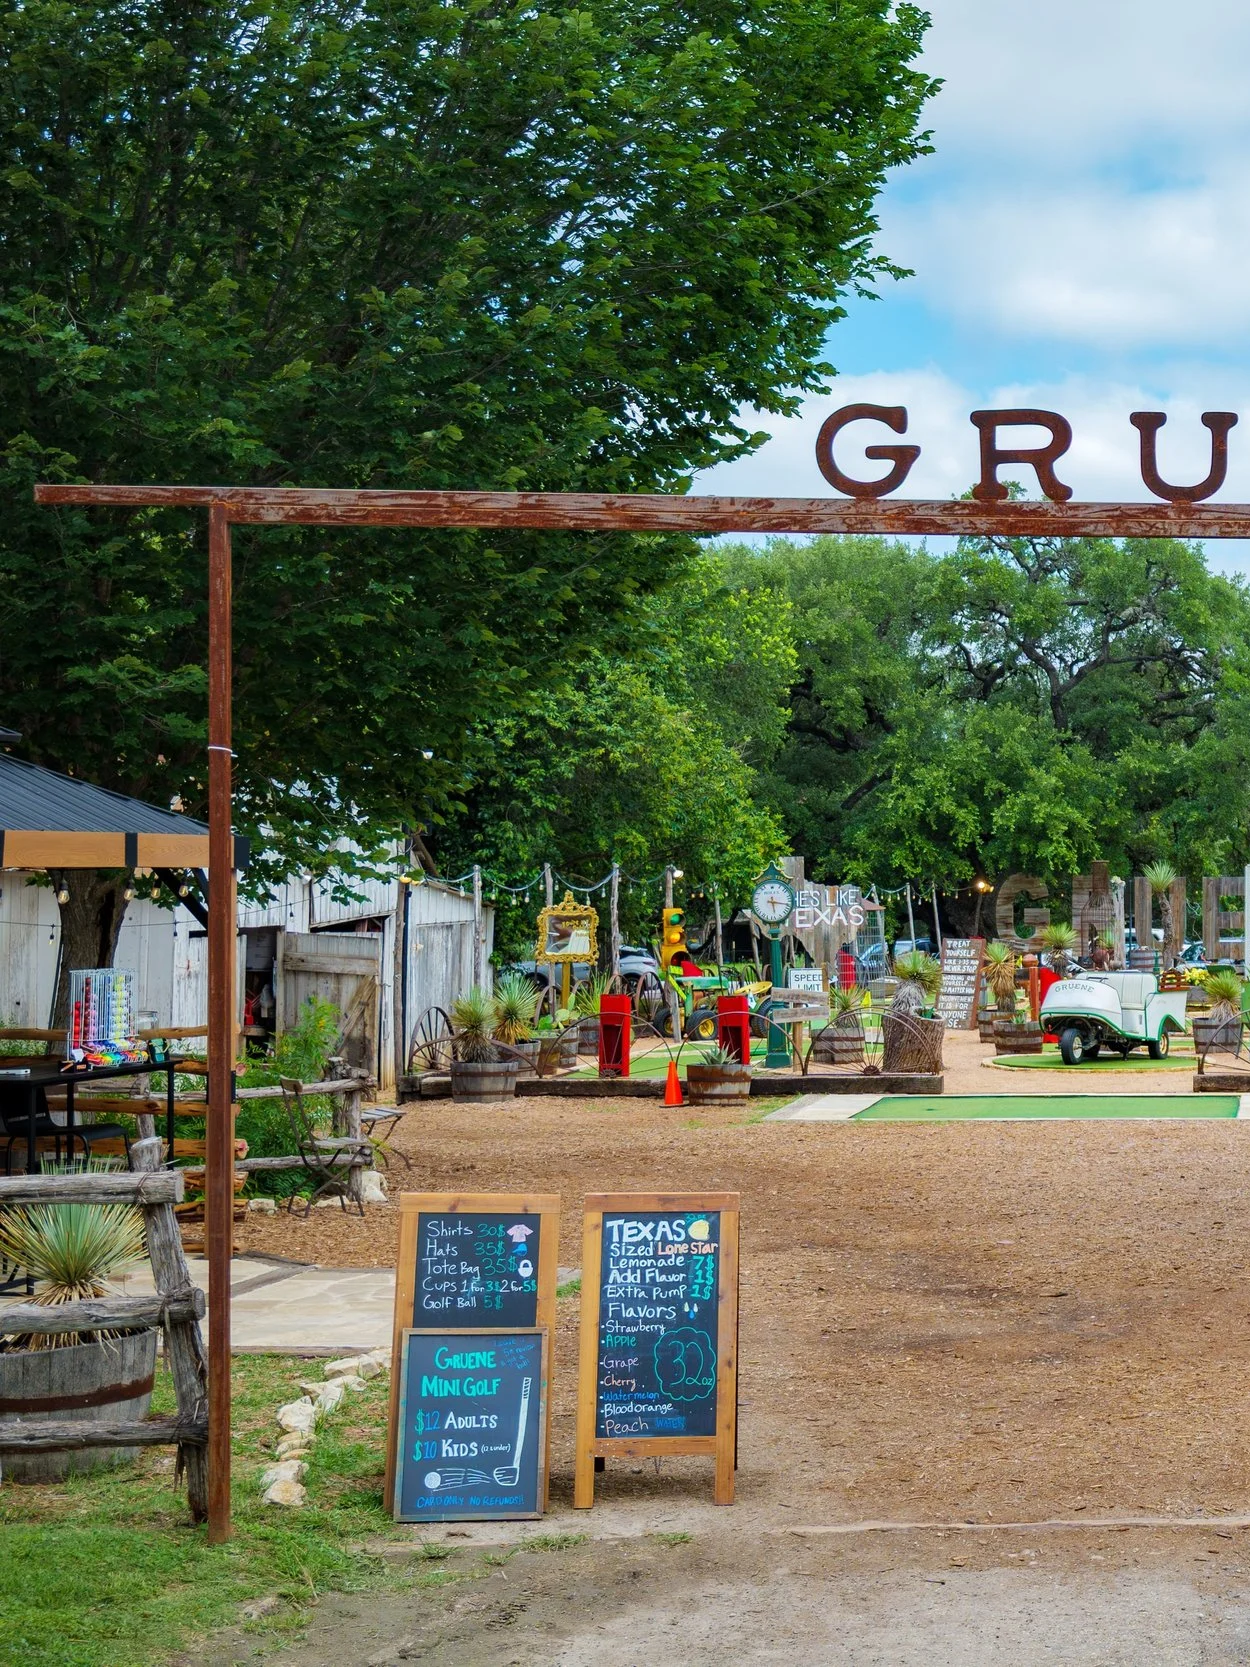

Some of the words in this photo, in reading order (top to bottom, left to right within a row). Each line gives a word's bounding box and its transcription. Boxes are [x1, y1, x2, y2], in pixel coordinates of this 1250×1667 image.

[825, 889, 860, 906] LIKE
[946, 940, 971, 948] TREAT
[945, 949, 976, 957] YOURSELF
[962, 965, 977, 973] STOP
[1054, 983, 1095, 993] GRUENE
[954, 1002, 969, 1010] FOR
[427, 1220, 474, 1237] Shirts
[477, 1223, 506, 1238] 30$
[606, 1218, 686, 1242] TEXAS
[425, 1238, 458, 1256] Hats
[473, 1240, 506, 1256] 35$
[610, 1241, 654, 1257] Sized
[657, 1242, 689, 1255] Lone
[421, 1257, 458, 1275] Tote
[460, 1262, 481, 1280] Bag
[482, 1256, 518, 1276] 35$
[609, 1254, 686, 1269] Lemonade
[422, 1276, 458, 1293] Cups
[460, 1279, 468, 1293] 1
[500, 1279, 511, 1293] 2
[510, 1280, 523, 1292] for
[608, 1269, 641, 1284] Add
[645, 1268, 687, 1283] Flavor
[606, 1285, 649, 1299] Extra
[422, 1294, 454, 1310] Golf
[457, 1296, 477, 1308] Ball
[608, 1302, 677, 1320] Flavors
[605, 1319, 666, 1335] Strawberry
[434, 1346, 497, 1370] GRUENE
[603, 1355, 639, 1373] Grape
[668, 1340, 702, 1386] 32
[421, 1375, 461, 1397] MINI
[463, 1377, 502, 1397] GOLF
[603, 1373, 637, 1392] Cherry
[414, 1409, 440, 1435] $12
[444, 1411, 499, 1429] ADULTS
[605, 1416, 649, 1437] Peach
[412, 1440, 438, 1462] $10
[441, 1438, 478, 1458] KIDS
